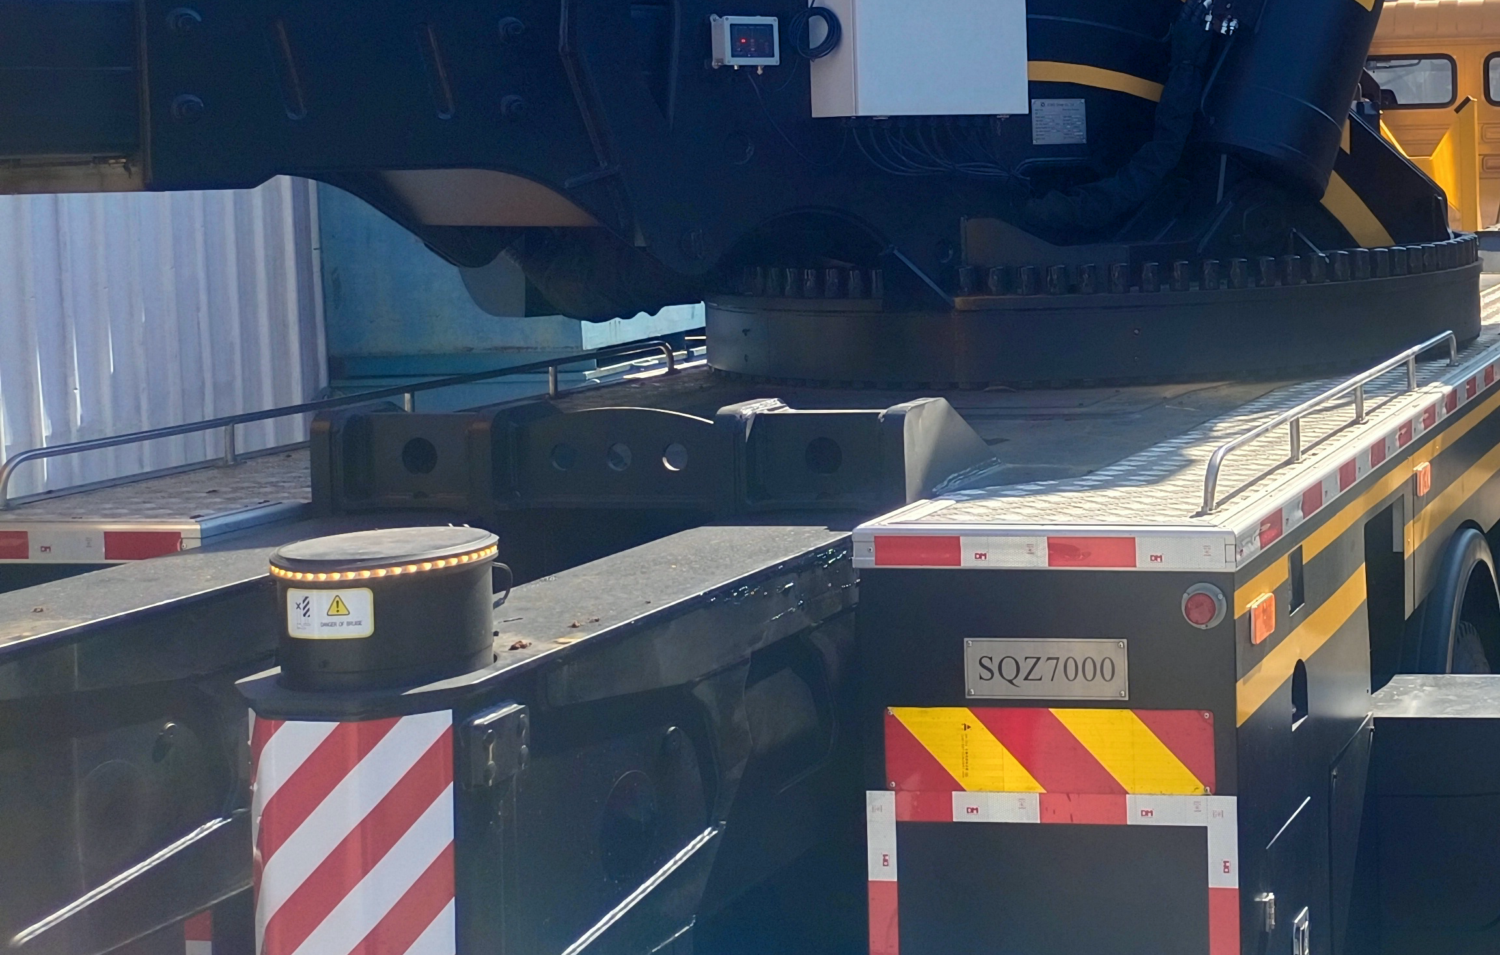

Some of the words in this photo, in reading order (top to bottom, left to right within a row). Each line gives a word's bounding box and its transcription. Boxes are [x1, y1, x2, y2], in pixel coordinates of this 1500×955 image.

[975, 552, 987, 560] DM
[1150, 554, 1163, 562] DM
[978, 655, 1116, 688] SQZ7000
[966, 806, 979, 814] DM
